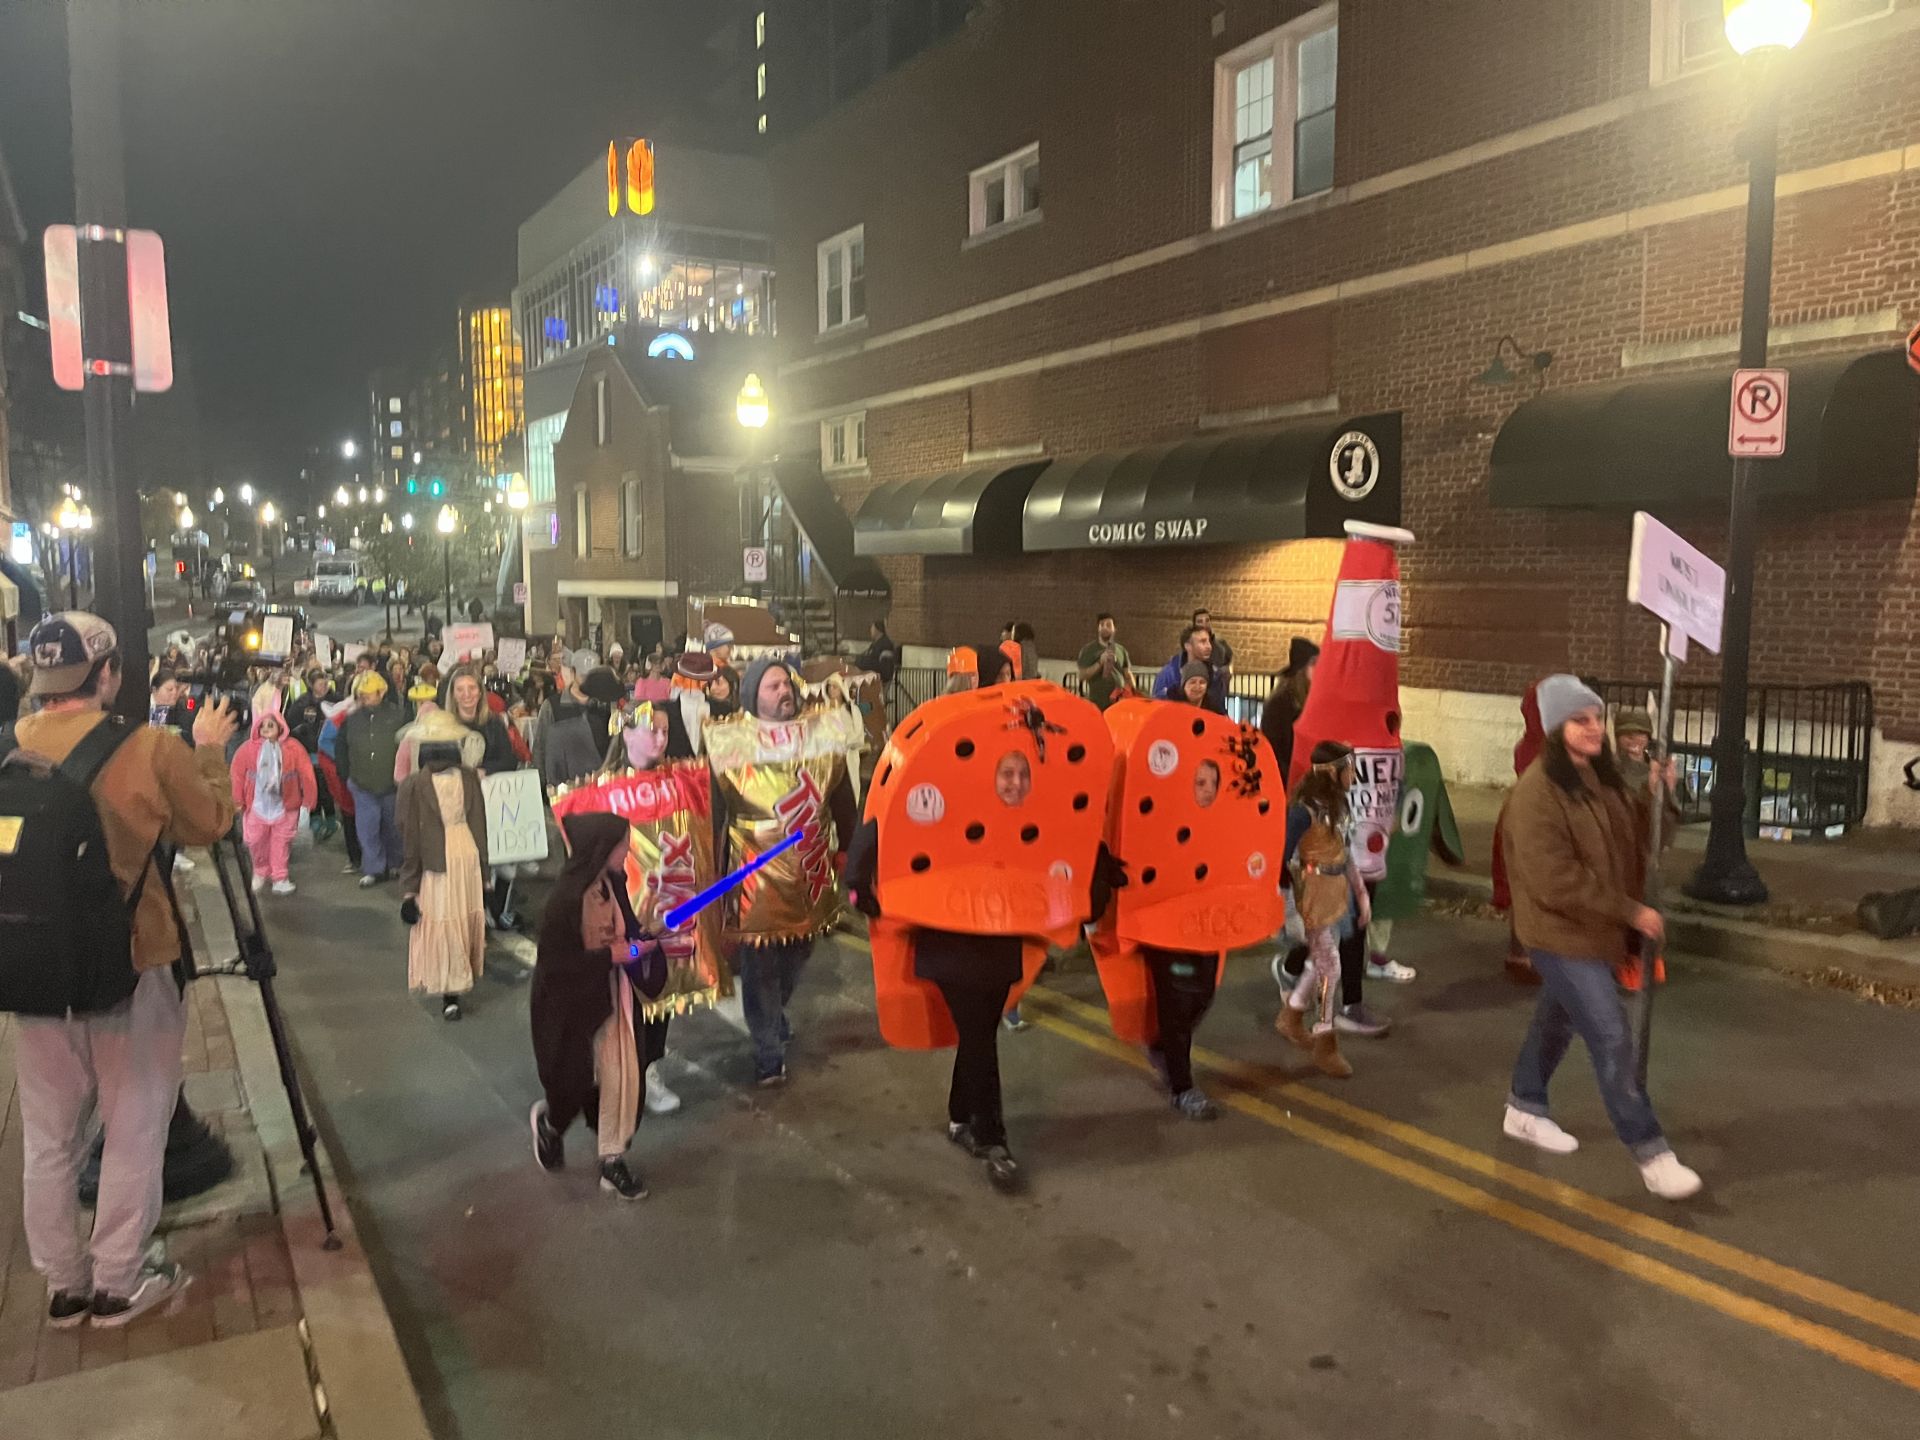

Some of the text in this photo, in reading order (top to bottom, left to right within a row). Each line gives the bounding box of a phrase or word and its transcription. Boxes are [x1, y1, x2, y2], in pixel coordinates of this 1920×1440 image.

[1089, 518, 1208, 543] COMIC SWAP
[485, 776, 525, 800] YOU
[501, 799, 521, 827] N
[774, 768, 833, 907] TWIX
